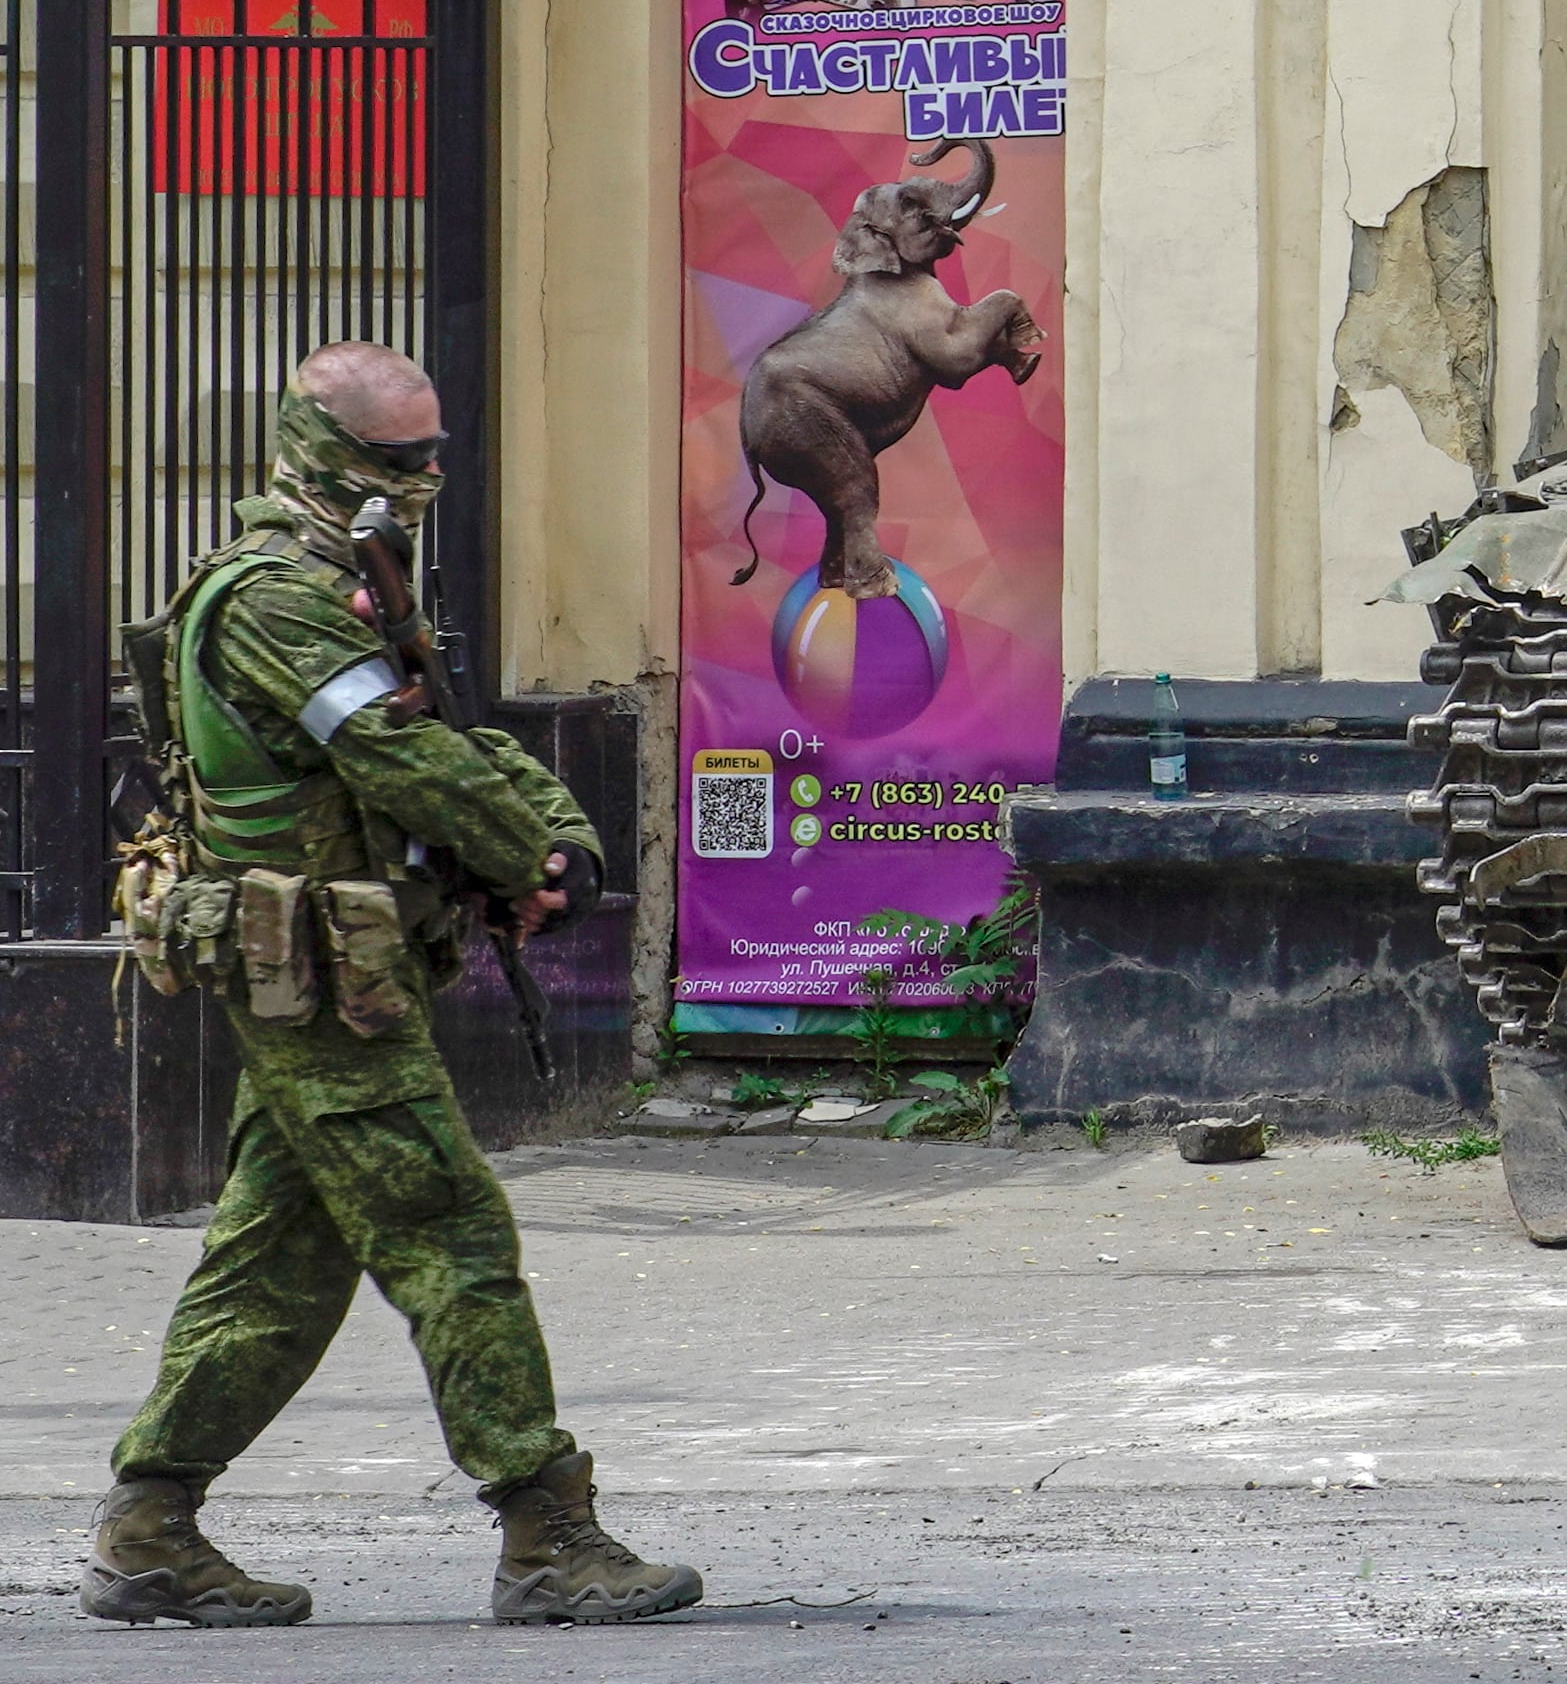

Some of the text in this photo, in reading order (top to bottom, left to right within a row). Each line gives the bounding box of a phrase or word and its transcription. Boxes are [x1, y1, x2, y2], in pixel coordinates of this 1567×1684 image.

[763, 3, 1061, 32] СКАЗОЧНОЕ ЦИРКОВОЕ ШОУ
[908, 88, 1066, 137] БИЛЕ
[780, 729, 825, 760] 0+
[705, 756, 760, 770] БИЛЕТЫ
[830, 783, 862, 804] +7
[872, 782, 943, 809] (863)
[814, 920, 850, 938] ФКП
[730, 939, 845, 959] Юридический
[850, 942, 902, 958] адрес:
[780, 962, 804, 978] ул.
[903, 959, 935, 978] д.4,
[680, 980, 724, 995] ОГРН
[728, 980, 840, 996] 1027739272527
